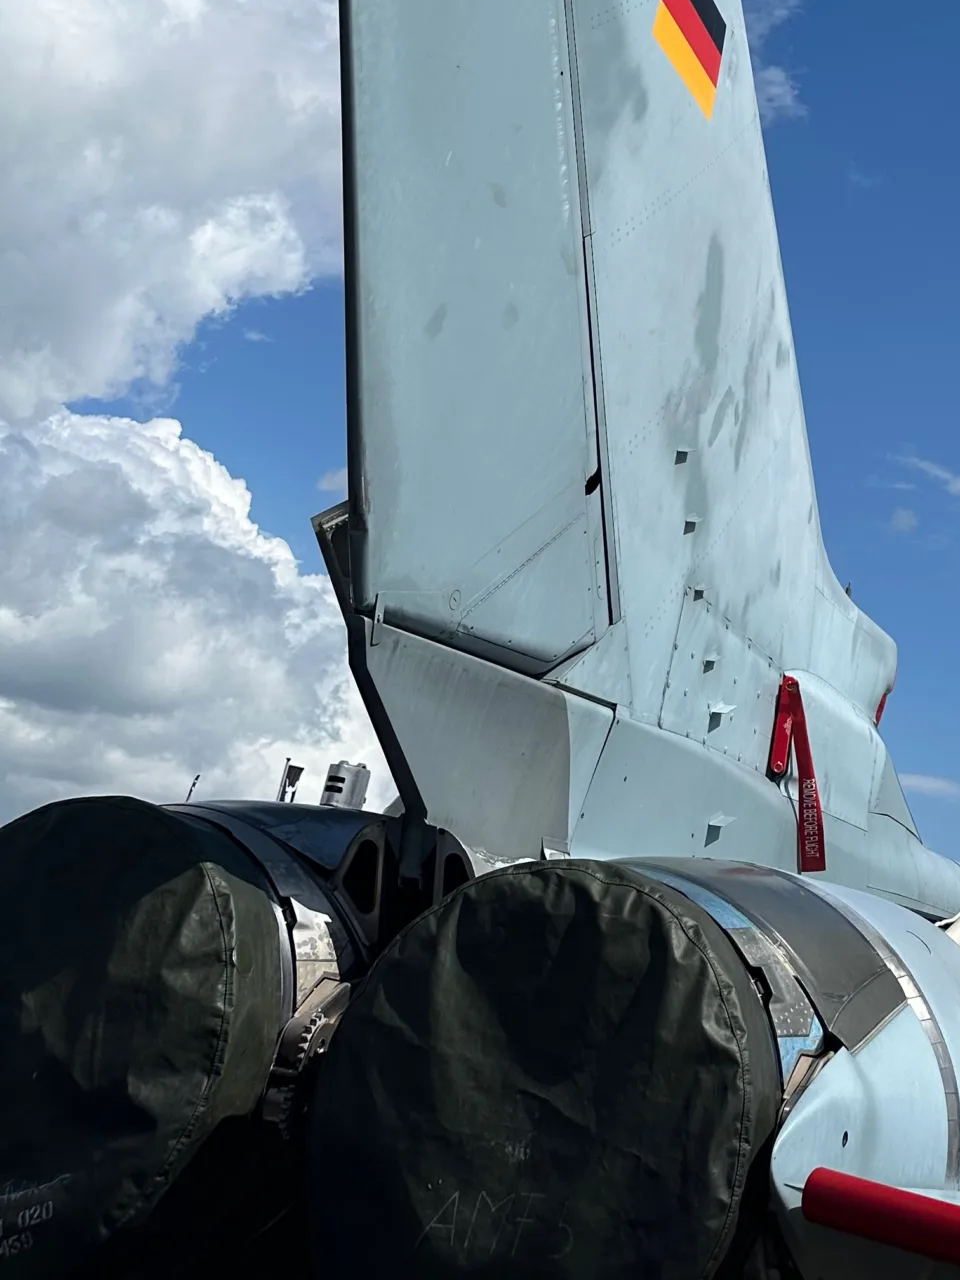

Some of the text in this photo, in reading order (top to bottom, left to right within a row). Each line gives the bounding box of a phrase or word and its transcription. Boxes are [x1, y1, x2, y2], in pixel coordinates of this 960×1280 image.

[803, 778, 819, 858] REMOVE BEFORE FLIGHT
